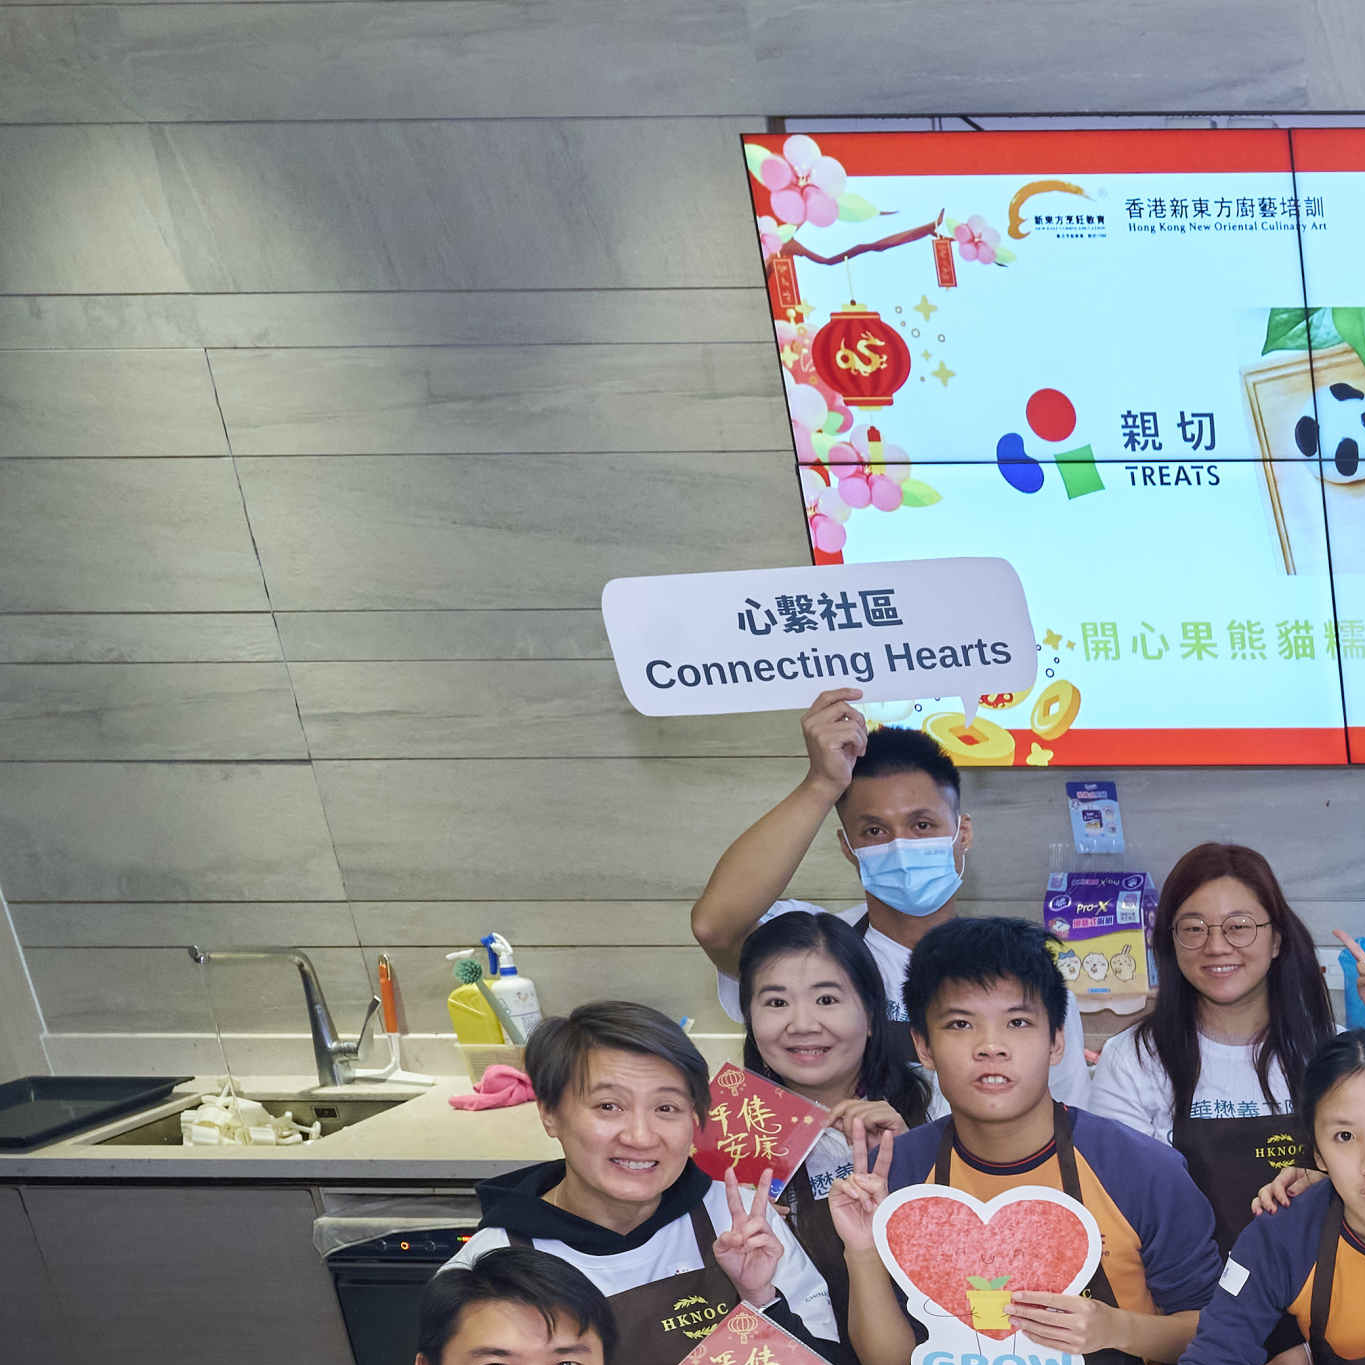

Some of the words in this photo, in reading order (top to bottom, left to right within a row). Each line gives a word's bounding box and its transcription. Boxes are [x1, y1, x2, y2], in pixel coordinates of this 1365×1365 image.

[1125, 196, 1325, 219] 香港新東方廚藝培訓
[1128, 222, 1156, 233] Hong
[1159, 222, 1186, 233] Kong
[1189, 222, 1211, 231] New
[1214, 221, 1258, 231] Oriental
[1261, 222, 1308, 234] Culinay
[1311, 222, 1327, 231] Art
[1120, 410, 1216, 452] 親切
[1125, 465, 1220, 486] TREATS
[737, 588, 904, 635] 心繫社區
[645, 645, 875, 689] Connecting
[884, 638, 1012, 674] Hearts
[661, 1303, 729, 1332] HKNOC
